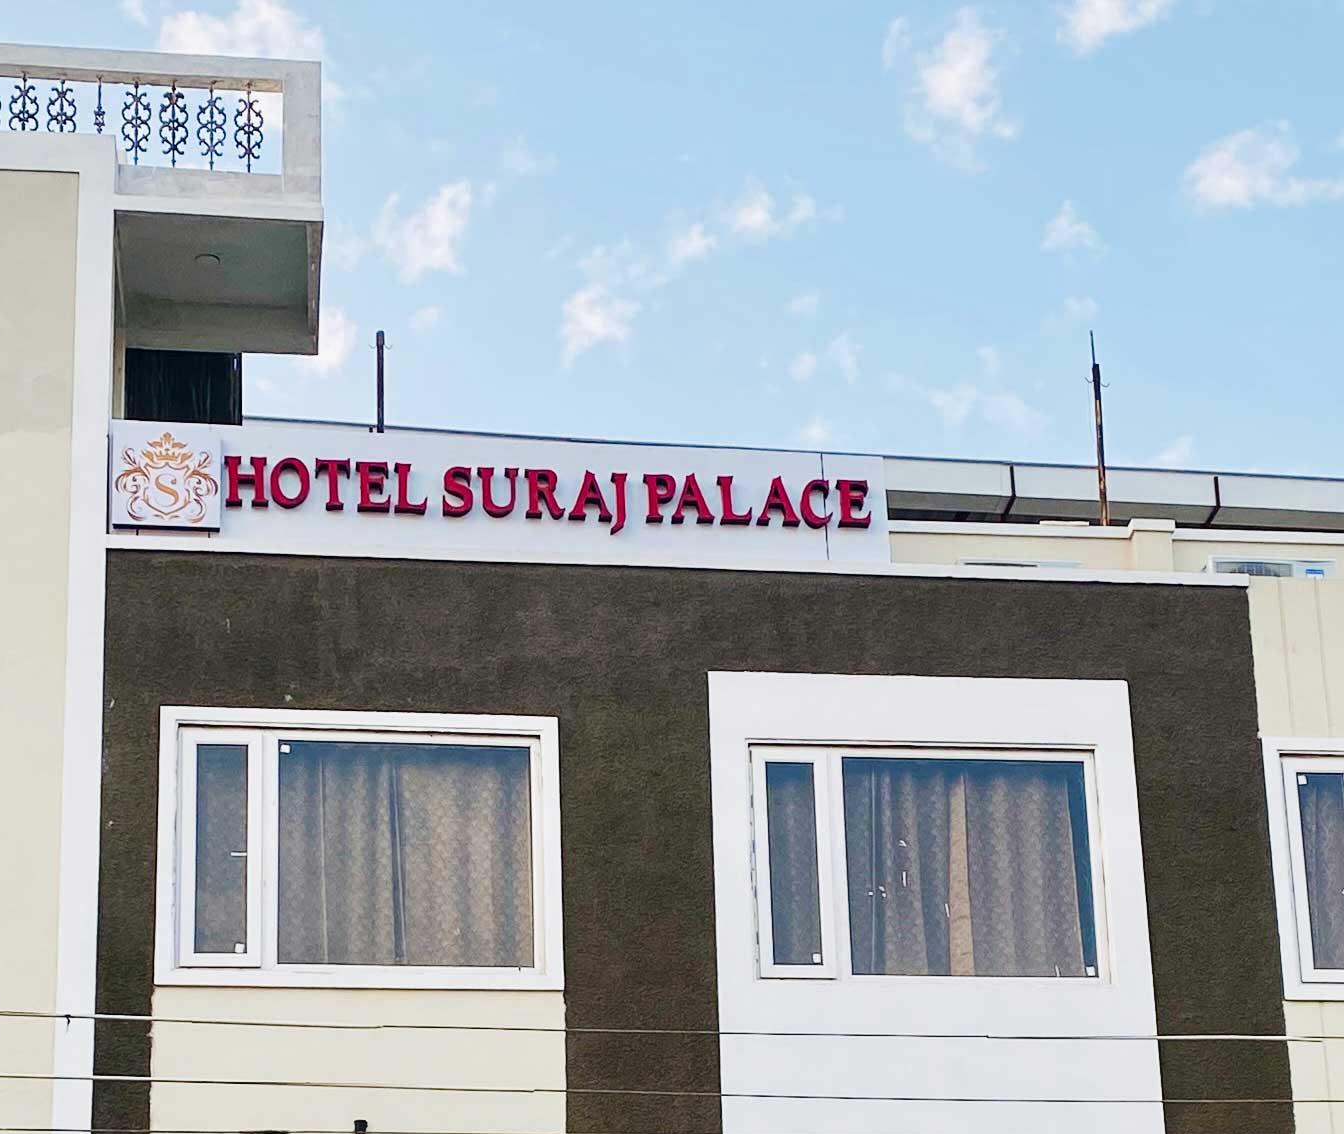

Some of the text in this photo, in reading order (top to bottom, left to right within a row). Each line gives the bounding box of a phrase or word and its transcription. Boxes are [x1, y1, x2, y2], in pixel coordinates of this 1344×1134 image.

[225, 455, 873, 535] HOTEL SURAJ PALACE
